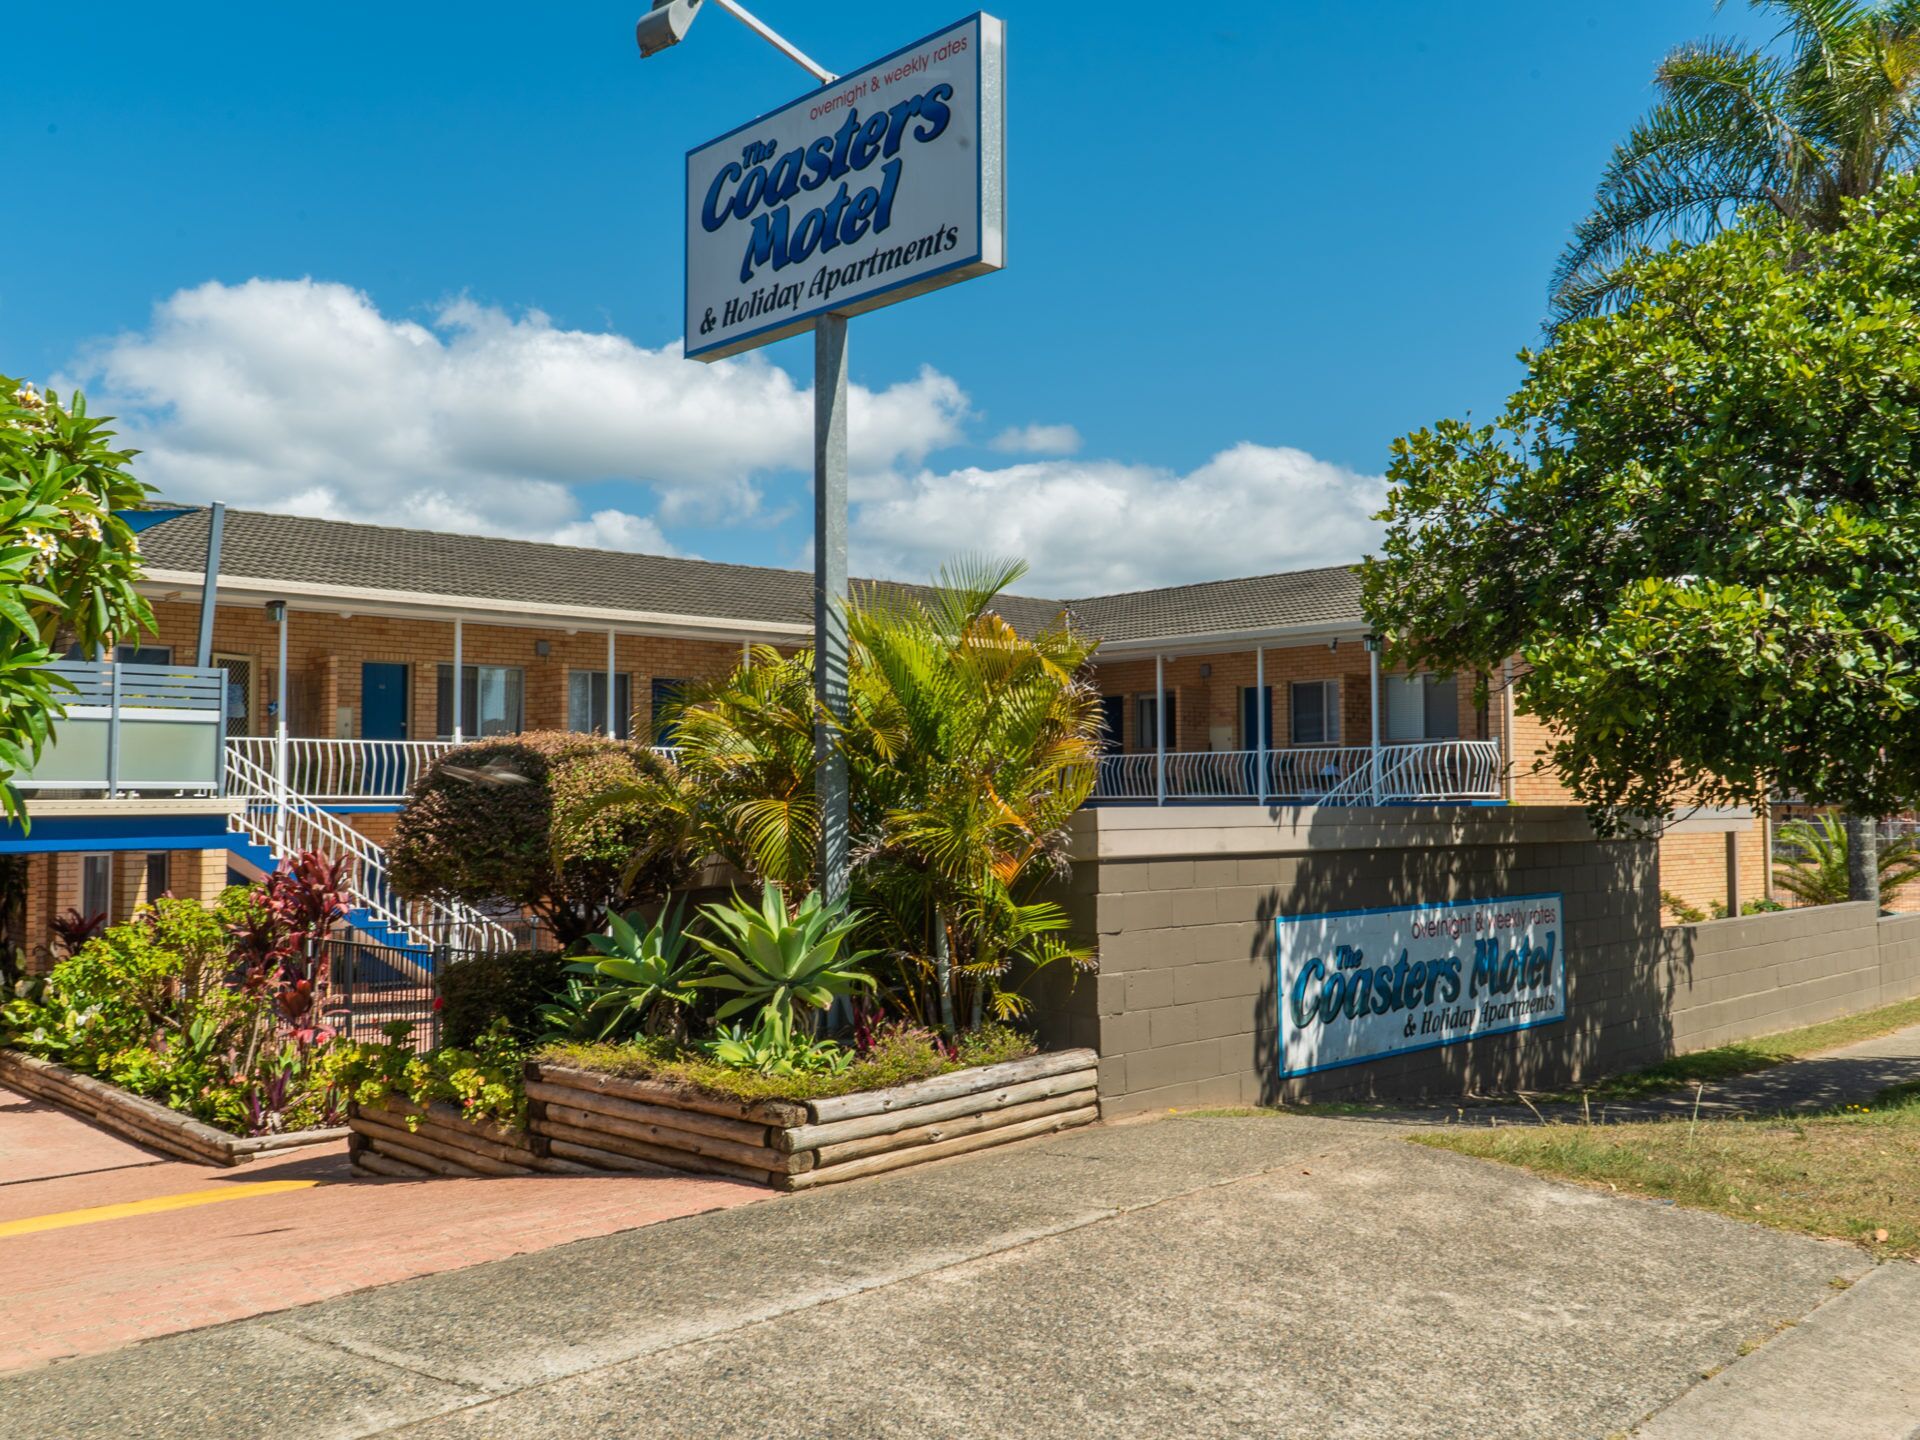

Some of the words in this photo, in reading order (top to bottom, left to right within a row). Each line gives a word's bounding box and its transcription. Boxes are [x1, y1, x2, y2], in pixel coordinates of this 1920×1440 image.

[809, 80, 867, 121] overnight
[870, 76, 880, 91] &
[884, 54, 929, 85] weekly
[932, 36, 968, 64] rates
[701, 82, 953, 233] Coasters
[742, 138, 777, 170] The
[740, 157, 903, 284] Motel
[699, 307, 716, 336] &
[722, 280, 805, 329] Holiday
[807, 223, 959, 300] Apartments
[1336, 945, 1363, 971] The
[1412, 917, 1471, 940] overnight
[1475, 911, 1483, 932] &
[1488, 907, 1527, 930] weekly
[1529, 906, 1556, 926] rates
[1290, 948, 1461, 1029] Coasters
[1469, 931, 1556, 999] Motel
[1404, 1014, 1416, 1038] &
[1420, 1006, 1475, 1035] Holiday
[1479, 993, 1555, 1024] Apartments
